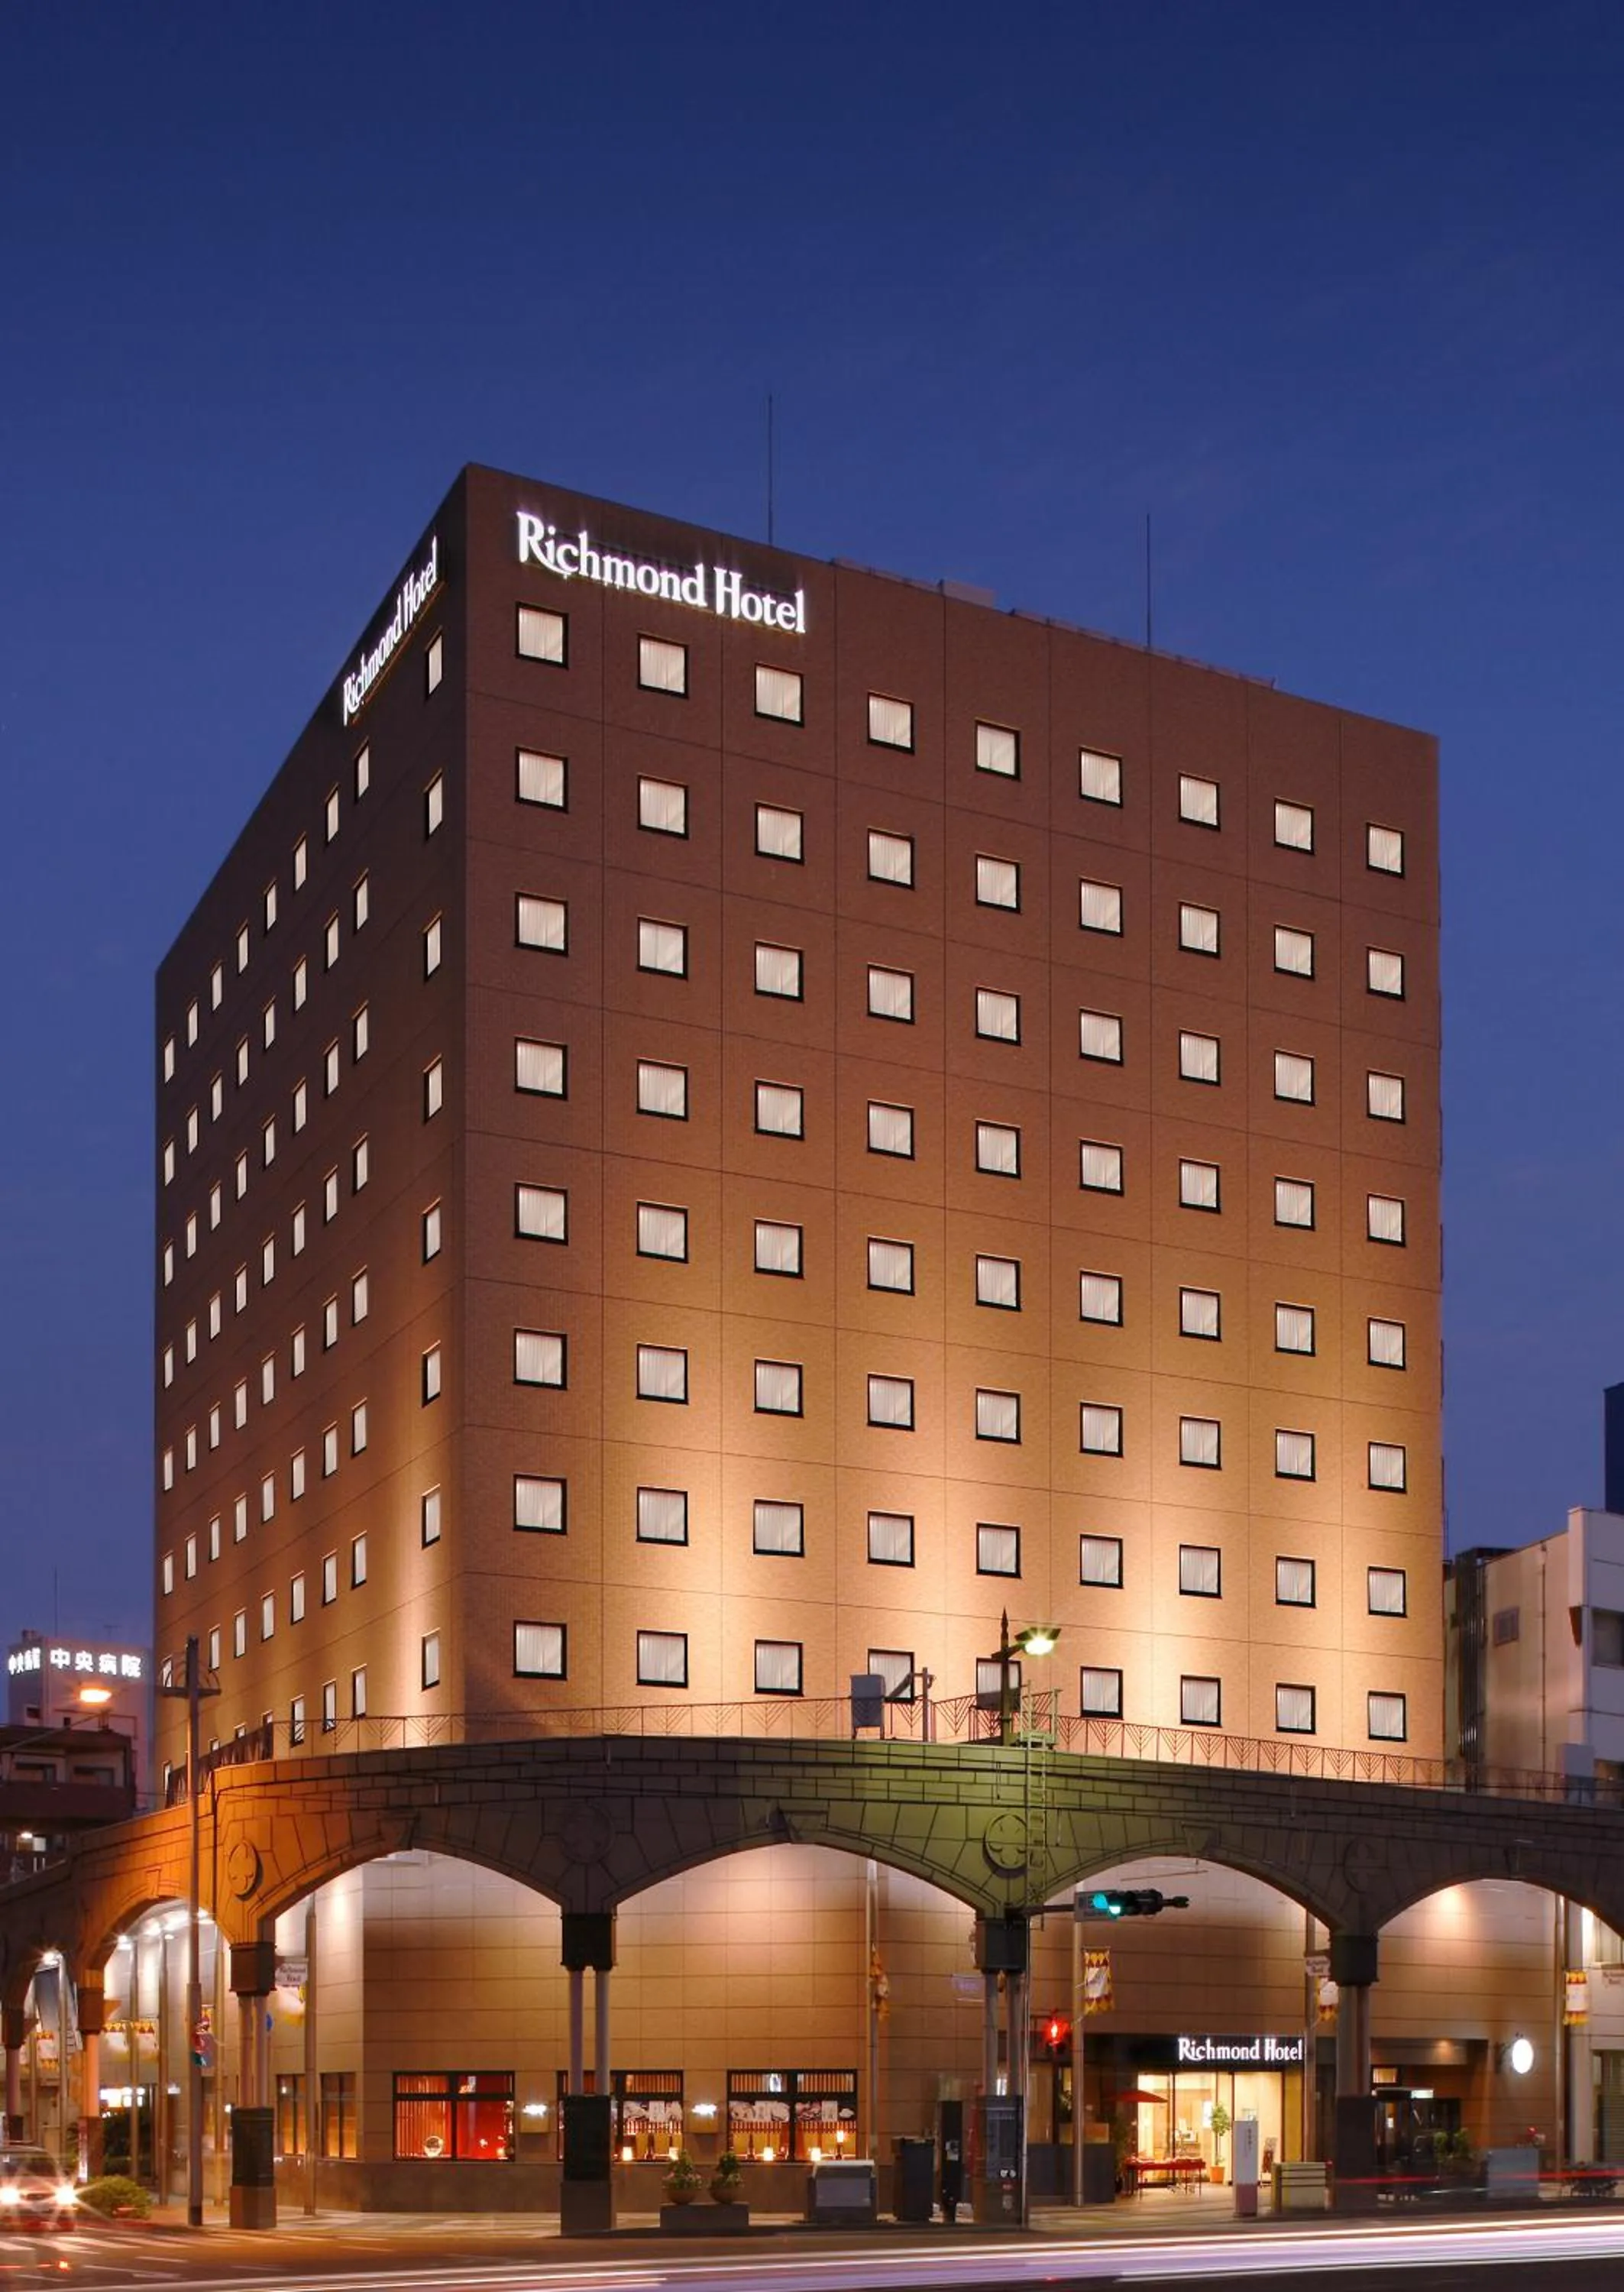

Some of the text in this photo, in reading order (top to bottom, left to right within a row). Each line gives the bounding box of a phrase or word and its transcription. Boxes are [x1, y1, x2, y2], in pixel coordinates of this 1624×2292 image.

[516, 511, 806, 633] Richmond Hotel
[343, 535, 437, 727] Richmond Hotel
[50, 1647, 141, 1678] 中央病院
[1178, 2038, 1302, 2061] Richmond Hotel
